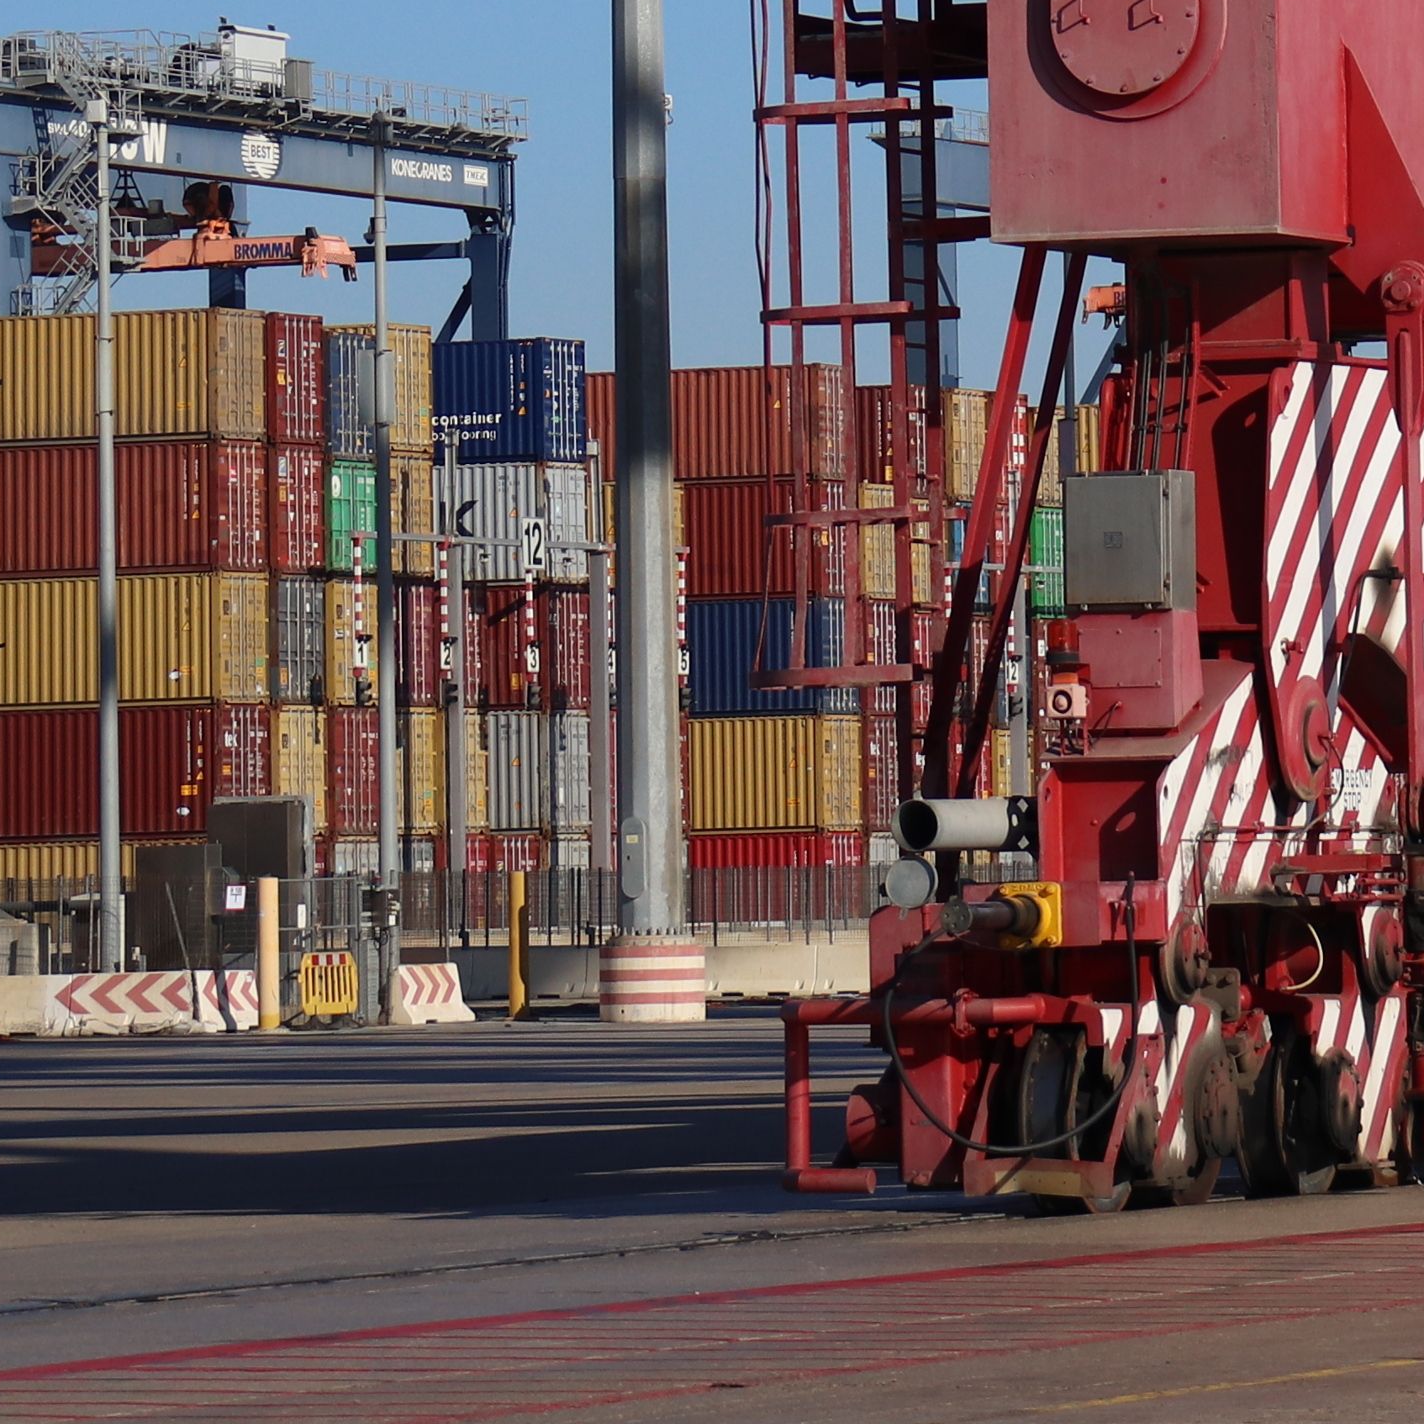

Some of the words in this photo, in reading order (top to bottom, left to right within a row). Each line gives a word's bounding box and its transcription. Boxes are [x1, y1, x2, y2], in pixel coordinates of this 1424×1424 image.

[251, 144, 272, 159] BEST
[391, 158, 452, 183] KONECRANES
[234, 242, 293, 260] BROMMA
[431, 412, 502, 427] container
[524, 521, 543, 566] 12
[358, 644, 364, 663] 1
[443, 646, 451, 667] 2
[530, 651, 536, 668] 3
[680, 651, 688, 671] 5
[1343, 792, 1361, 810] STOP
